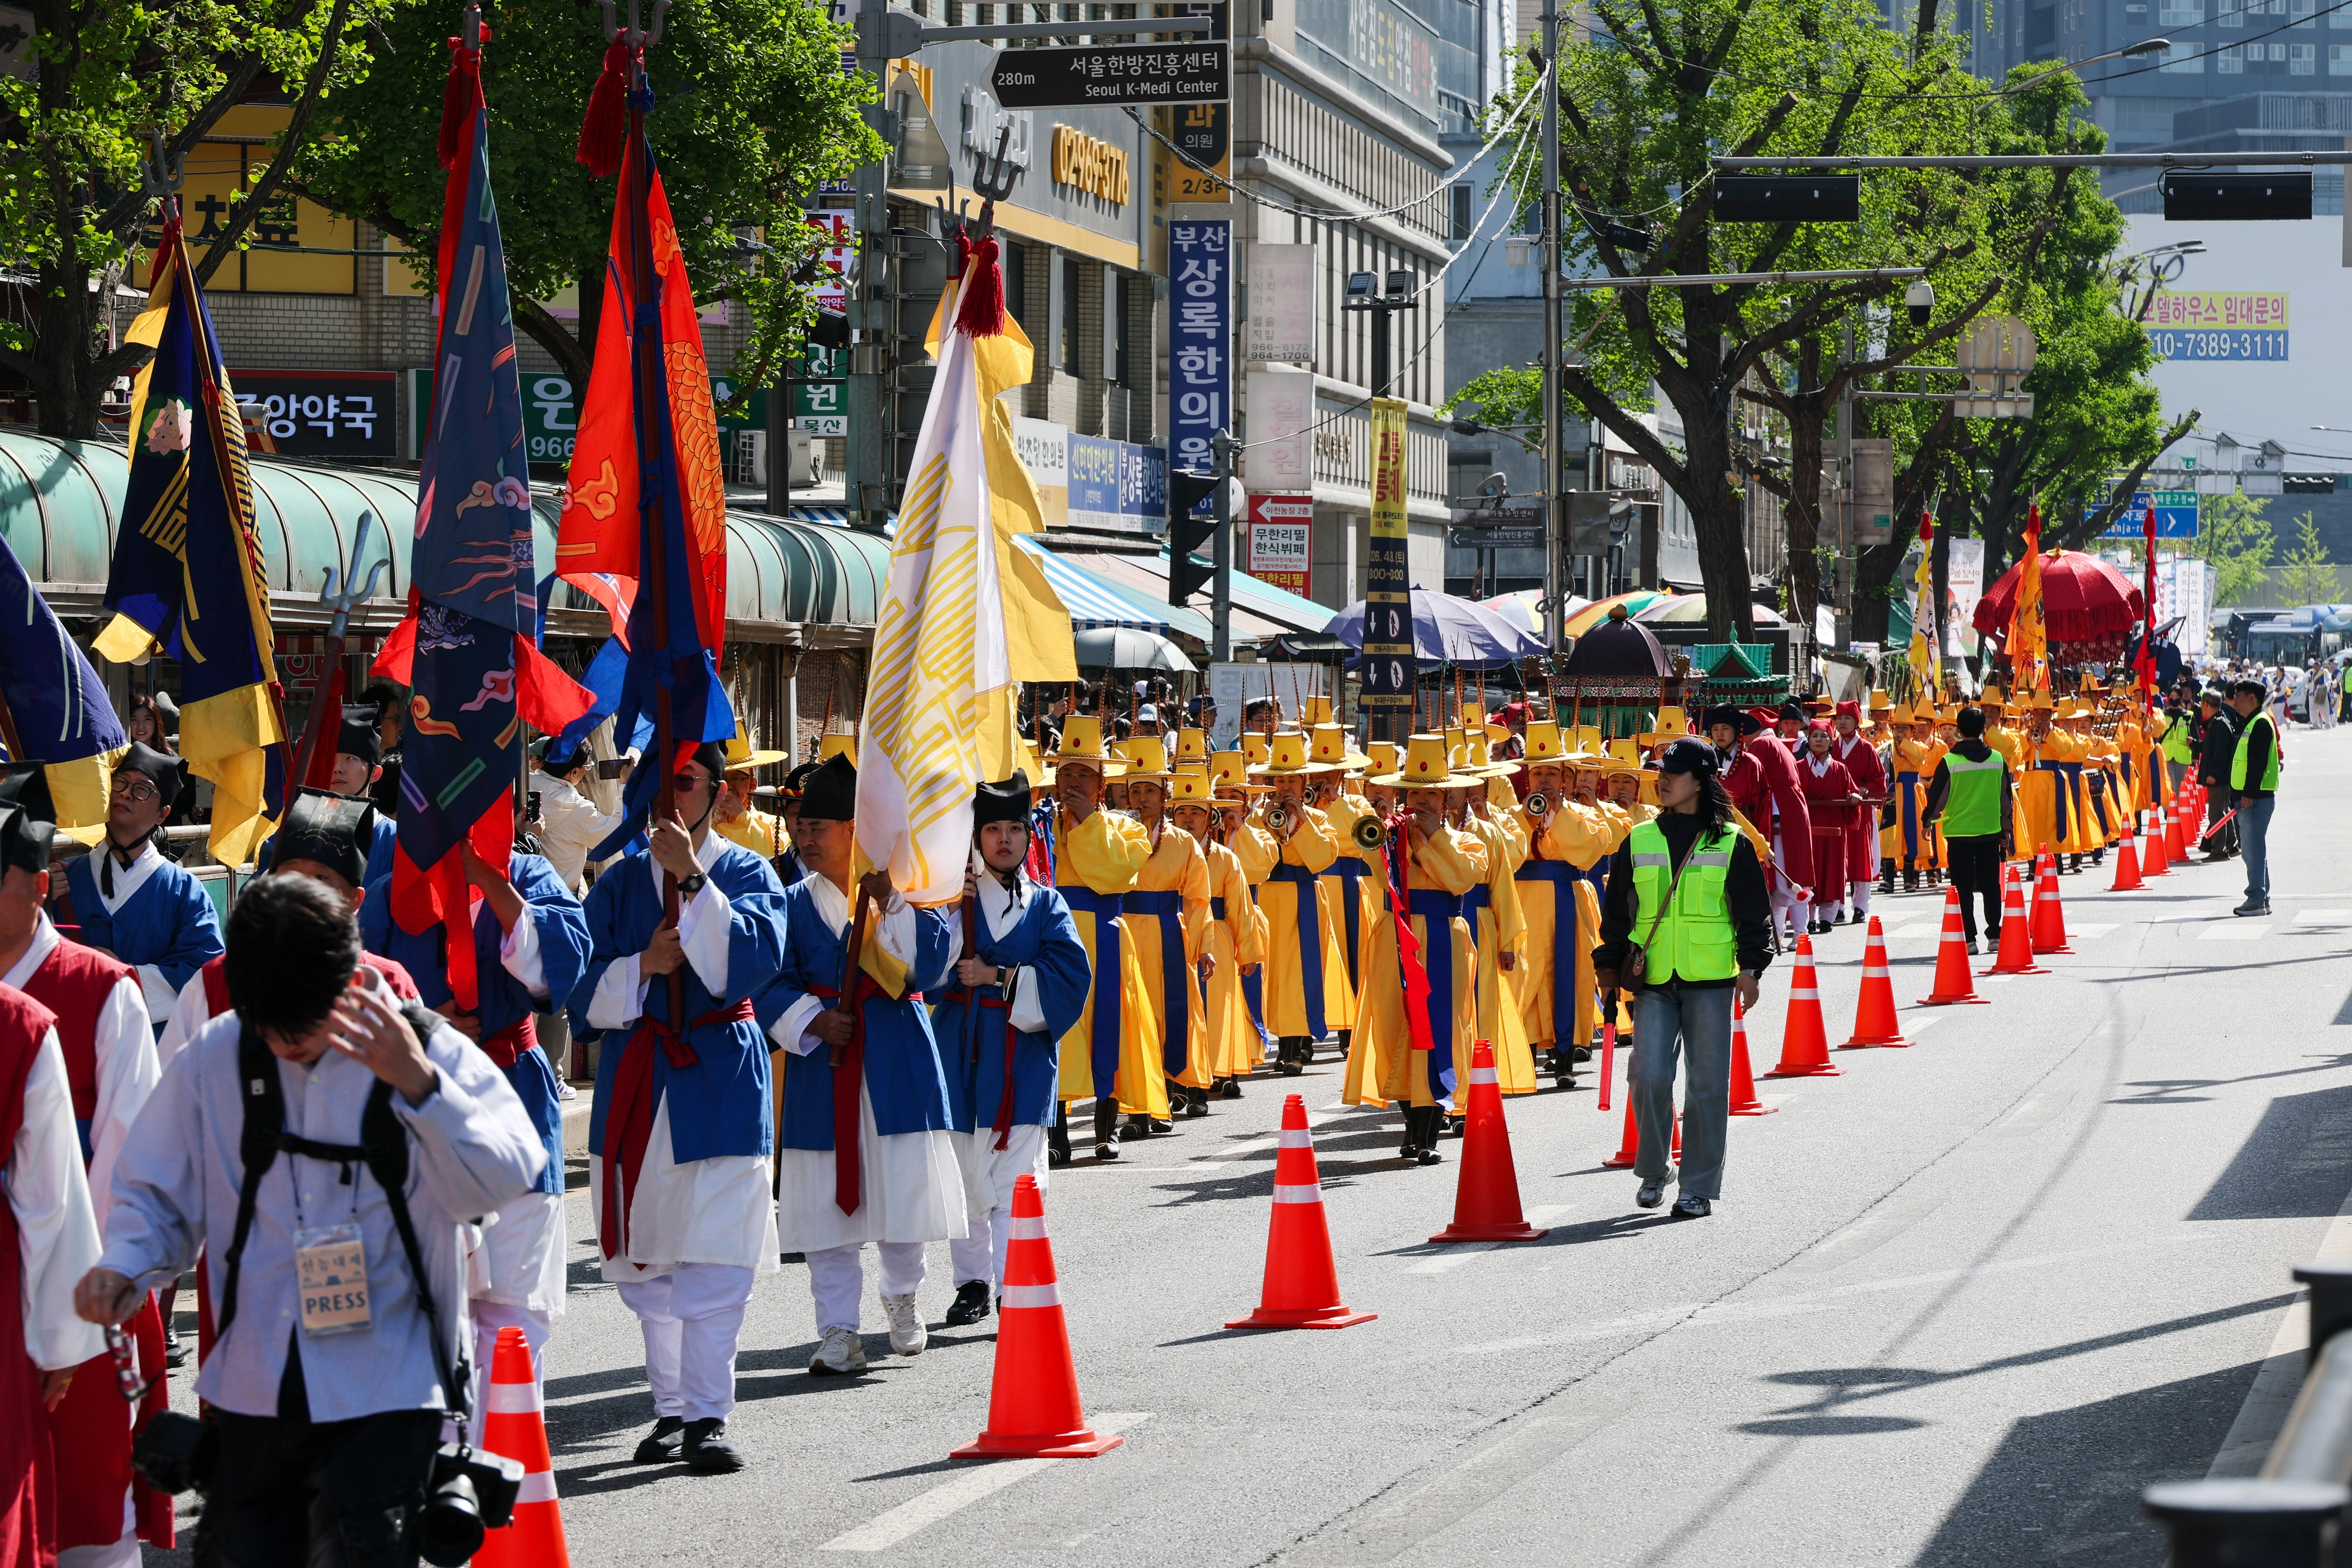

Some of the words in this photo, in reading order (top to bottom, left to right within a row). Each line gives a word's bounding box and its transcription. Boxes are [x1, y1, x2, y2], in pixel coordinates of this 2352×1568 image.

[1070, 52, 1218, 78] 서울한방진흥센터
[998, 72, 1035, 86] 280m
[1085, 84, 1121, 97] Seoul
[1127, 81, 1171, 95] K-Medi
[1176, 80, 1218, 93] Center
[1185, 134, 1213, 148] 의원
[1182, 178, 1222, 195] 2/3F
[1174, 226, 1227, 252] 부산
[2224, 296, 2284, 325] 임대문의
[2153, 332, 2284, 357] 10-7389-3111
[803, 419, 841, 434] 물산
[2157, 494, 2187, 505] 대문구청
[1266, 506, 1295, 515] 이천농장
[1298, 507, 1309, 515] 2층
[1255, 529, 1305, 541] 무한리필
[1255, 542, 1305, 555] 한식뷔페
[306, 1290, 366, 1314] PRESS
